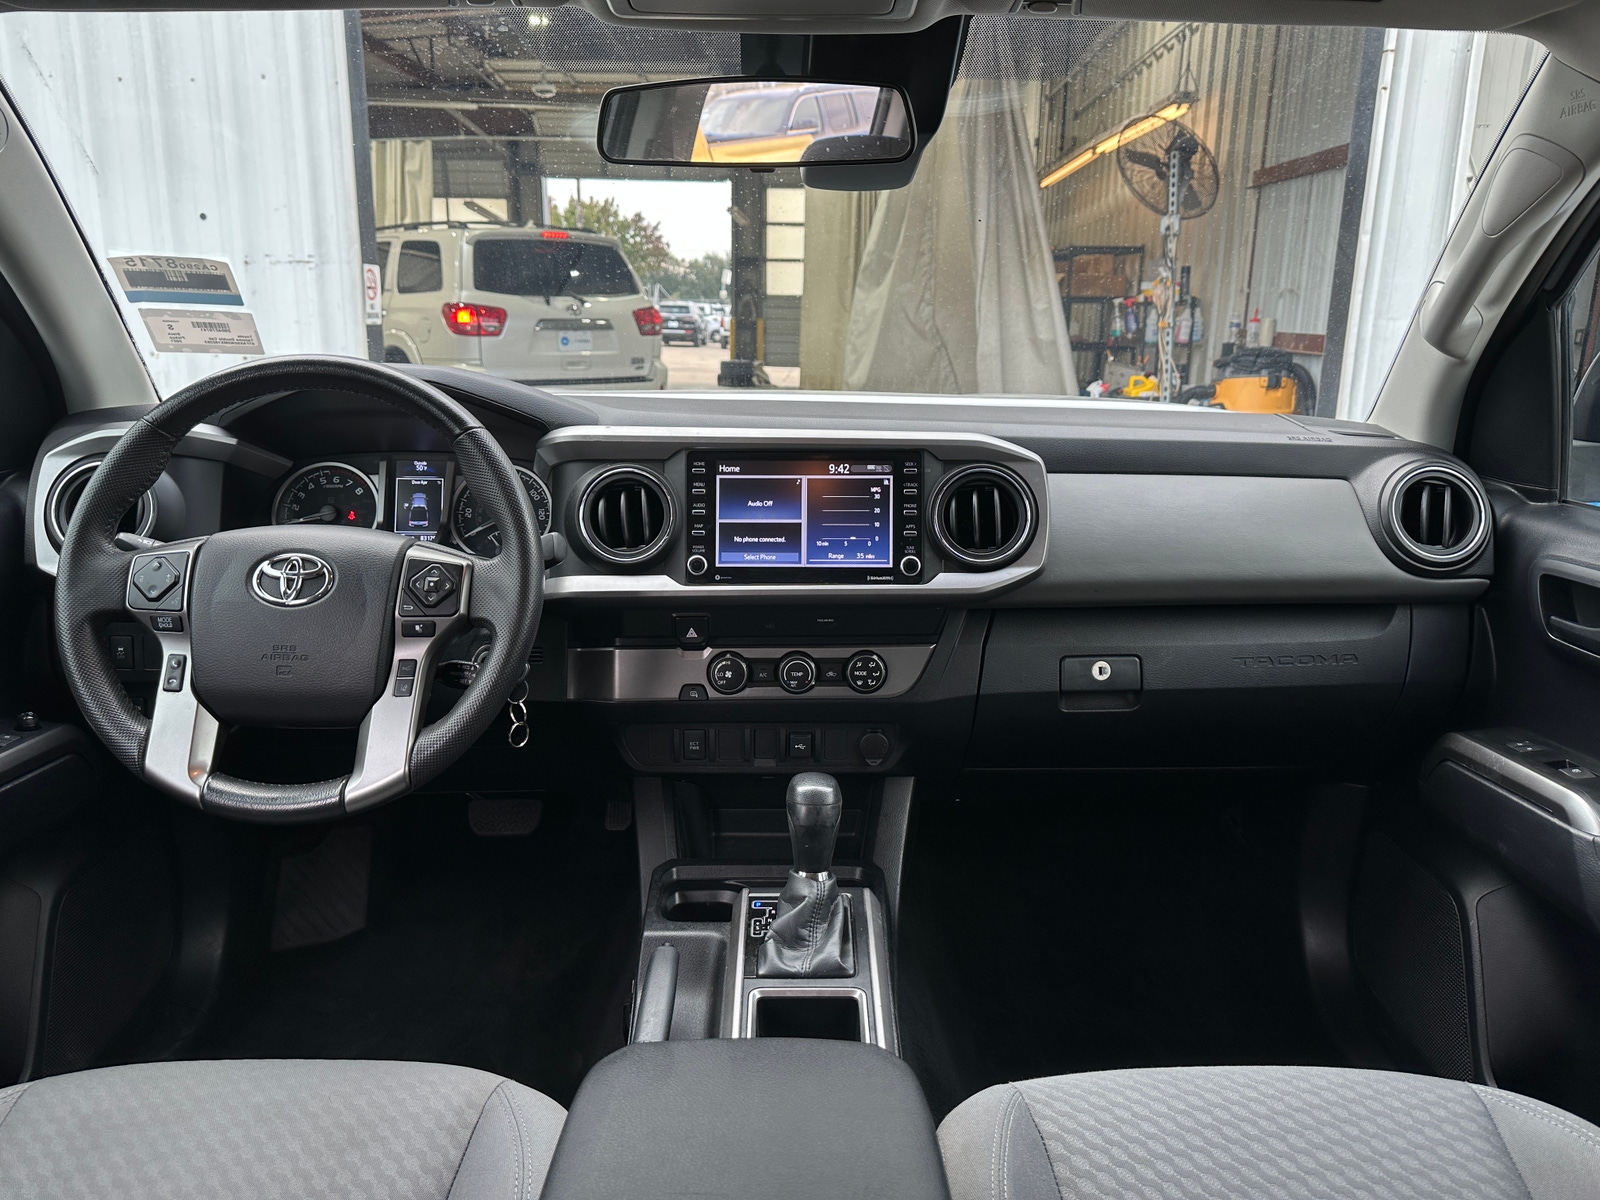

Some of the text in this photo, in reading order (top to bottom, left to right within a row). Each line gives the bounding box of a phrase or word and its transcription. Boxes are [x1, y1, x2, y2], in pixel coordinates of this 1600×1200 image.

[1570, 88, 1586, 101] SRS
[1559, 99, 1597, 119] AIRBAG
[719, 464, 740, 472] Home
[828, 464, 850, 474] 9:42
[355, 487, 364, 495] 8
[529, 489, 541, 501] 100
[465, 508, 472, 518] 20
[260, 654, 310, 662] AIRBAG
[1232, 653, 1358, 668] TACOMA
